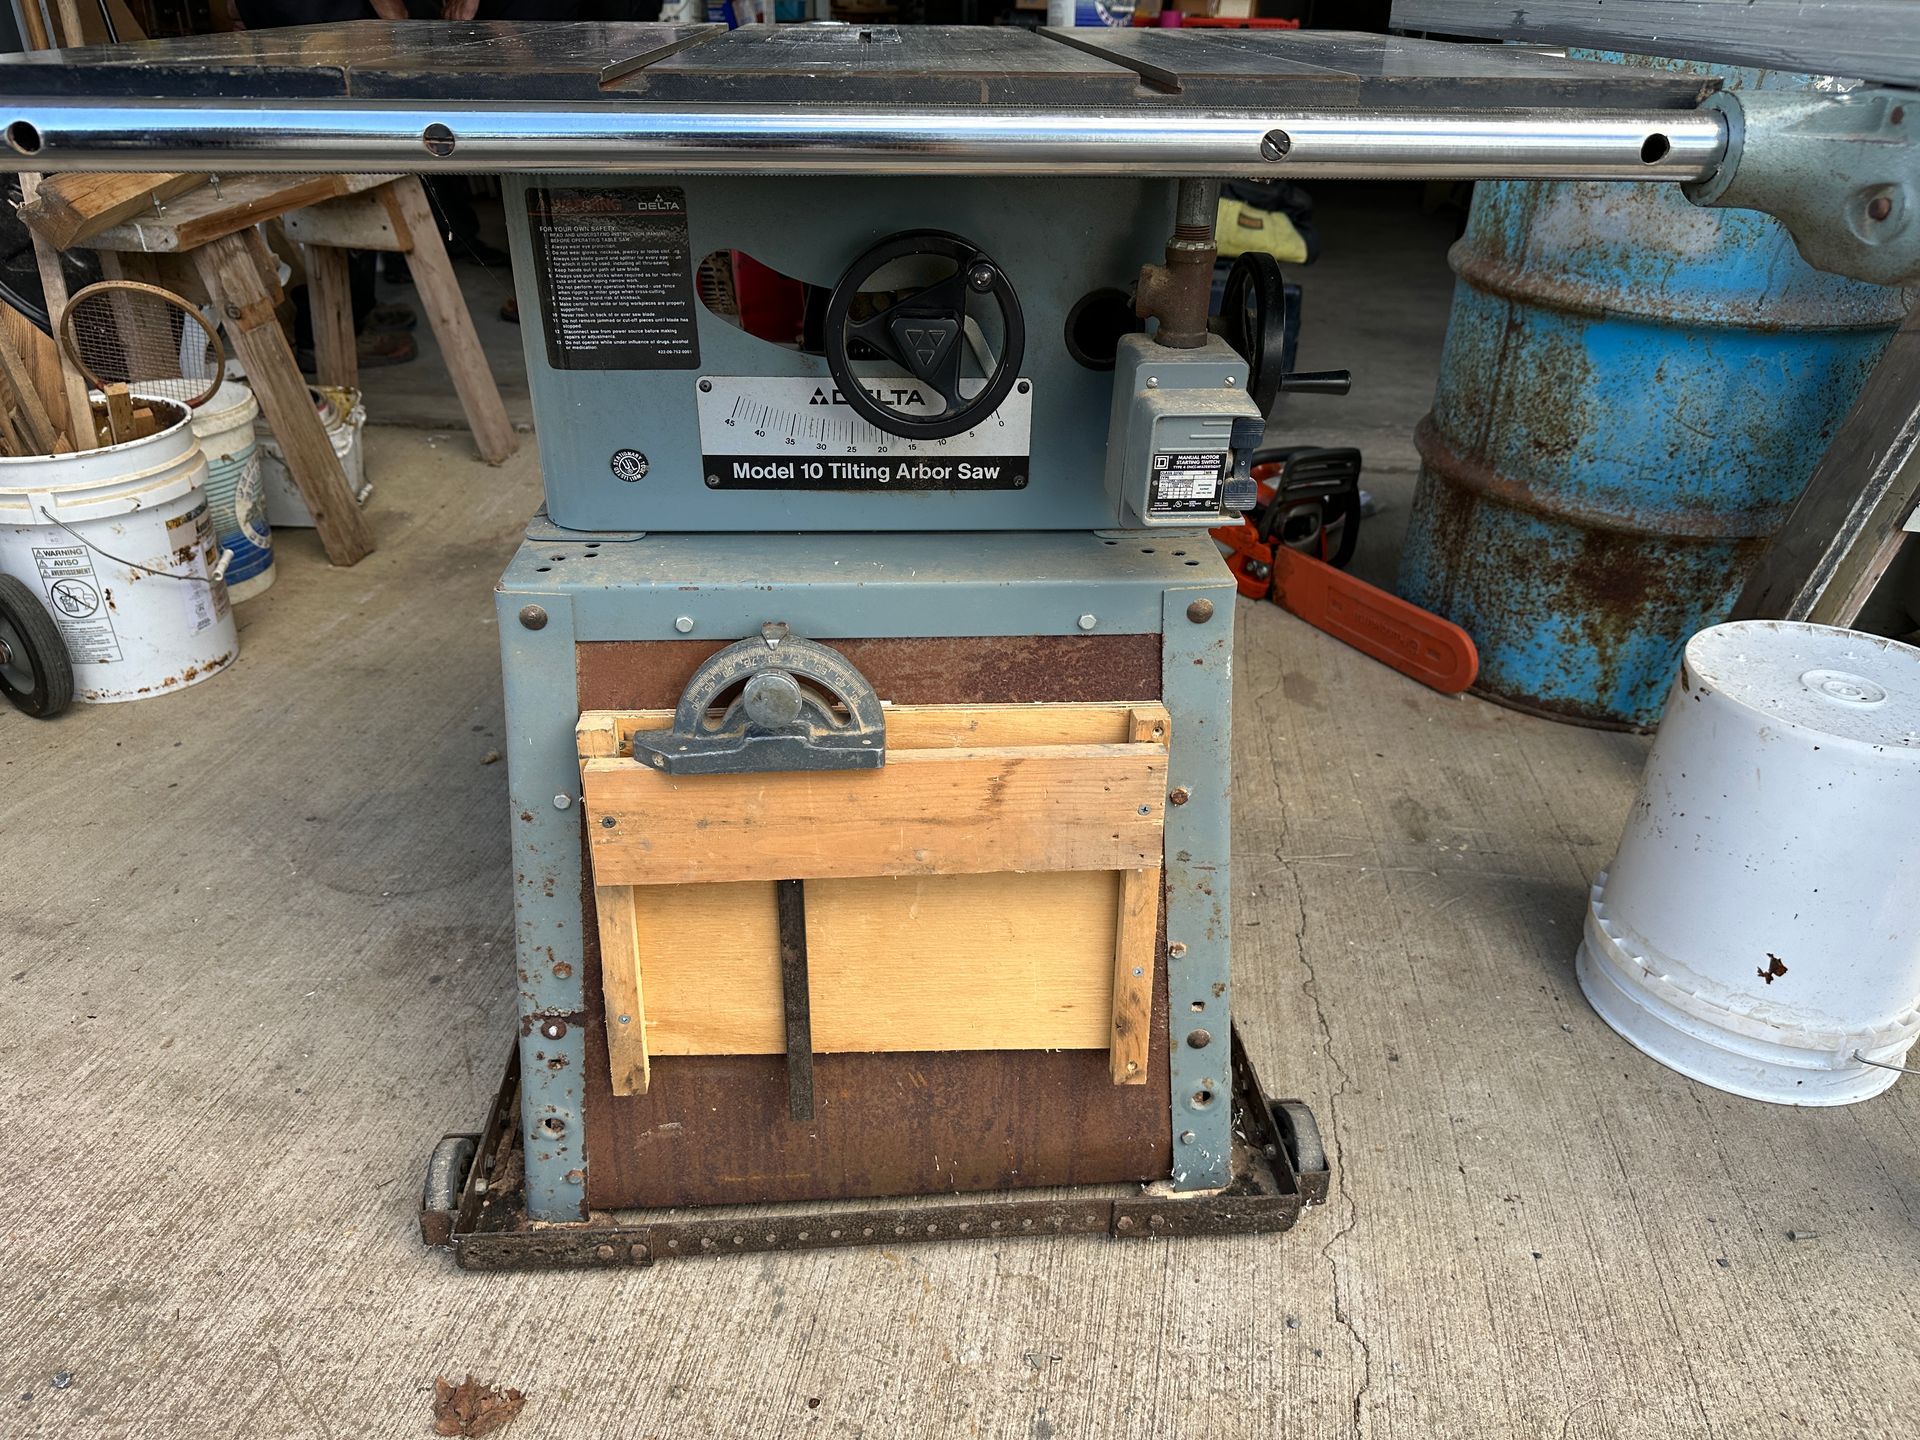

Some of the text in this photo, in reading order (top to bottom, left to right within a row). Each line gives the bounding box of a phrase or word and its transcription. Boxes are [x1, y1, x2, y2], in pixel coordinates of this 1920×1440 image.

[638, 201, 680, 210] DELTA
[833, 389, 926, 405] DLTA
[724, 418, 735, 427] 45
[754, 429, 766, 438] 40
[784, 438, 796, 446] 35
[816, 442, 826, 450] 30
[621, 459, 638, 471] UL
[732, 462, 1000, 483] Model 10 Tilting Arbor Saw
[43, 549, 83, 557] WARNING
